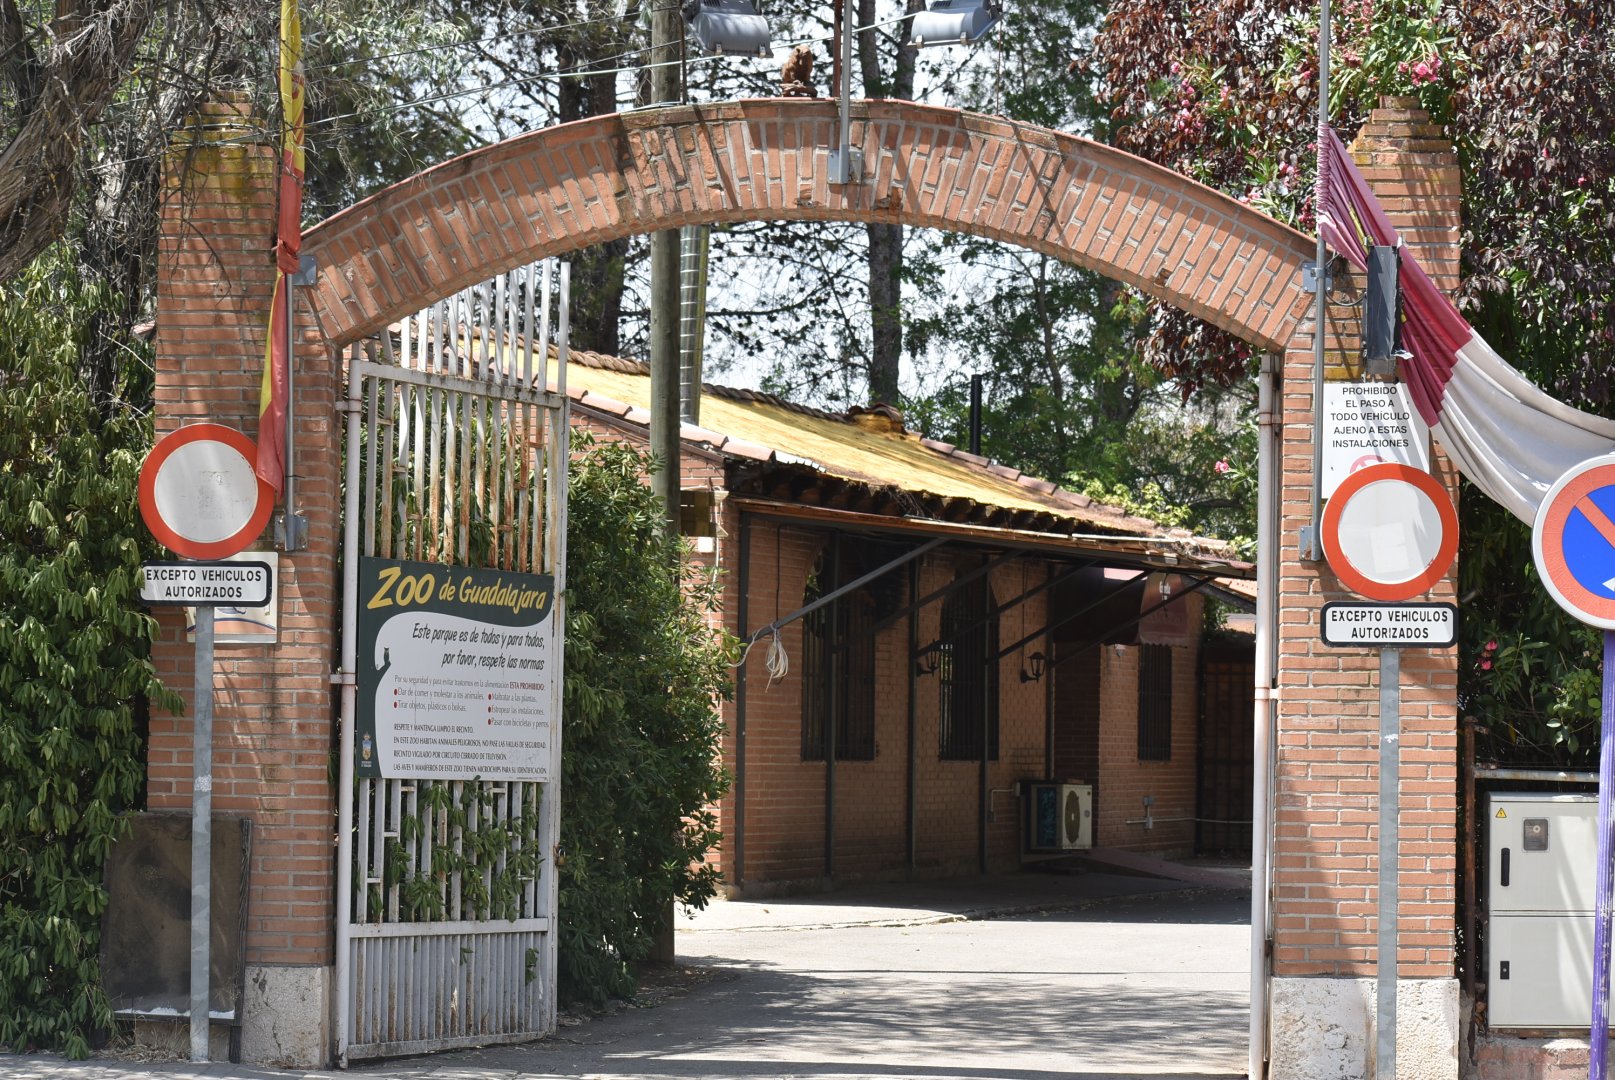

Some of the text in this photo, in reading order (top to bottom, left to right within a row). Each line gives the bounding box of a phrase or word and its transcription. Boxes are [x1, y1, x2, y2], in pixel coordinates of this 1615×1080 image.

[1342, 386, 1397, 395] PROHIBIDO
[1346, 399, 1394, 408] EL PASO A
[1330, 411, 1410, 421] TODO VEHÍCULO
[1334, 426, 1366, 434] AJENO
[1378, 426, 1407, 434] ESTAS
[1332, 439, 1409, 448] INSTALACIONES
[146, 569, 261, 582] EXCEPTO VEHICULOS
[165, 586, 242, 598] AUTORIZADOS
[439, 576, 456, 601] de
[458, 576, 547, 615] Guadalajara
[1331, 611, 1448, 622] EXCEPTO VEHICULOS
[412, 622, 545, 650] Este parque es de todos y para todos,
[1352, 627, 1429, 638] AUTORIZADOS
[441, 650, 545, 672] por favor, respete las normas
